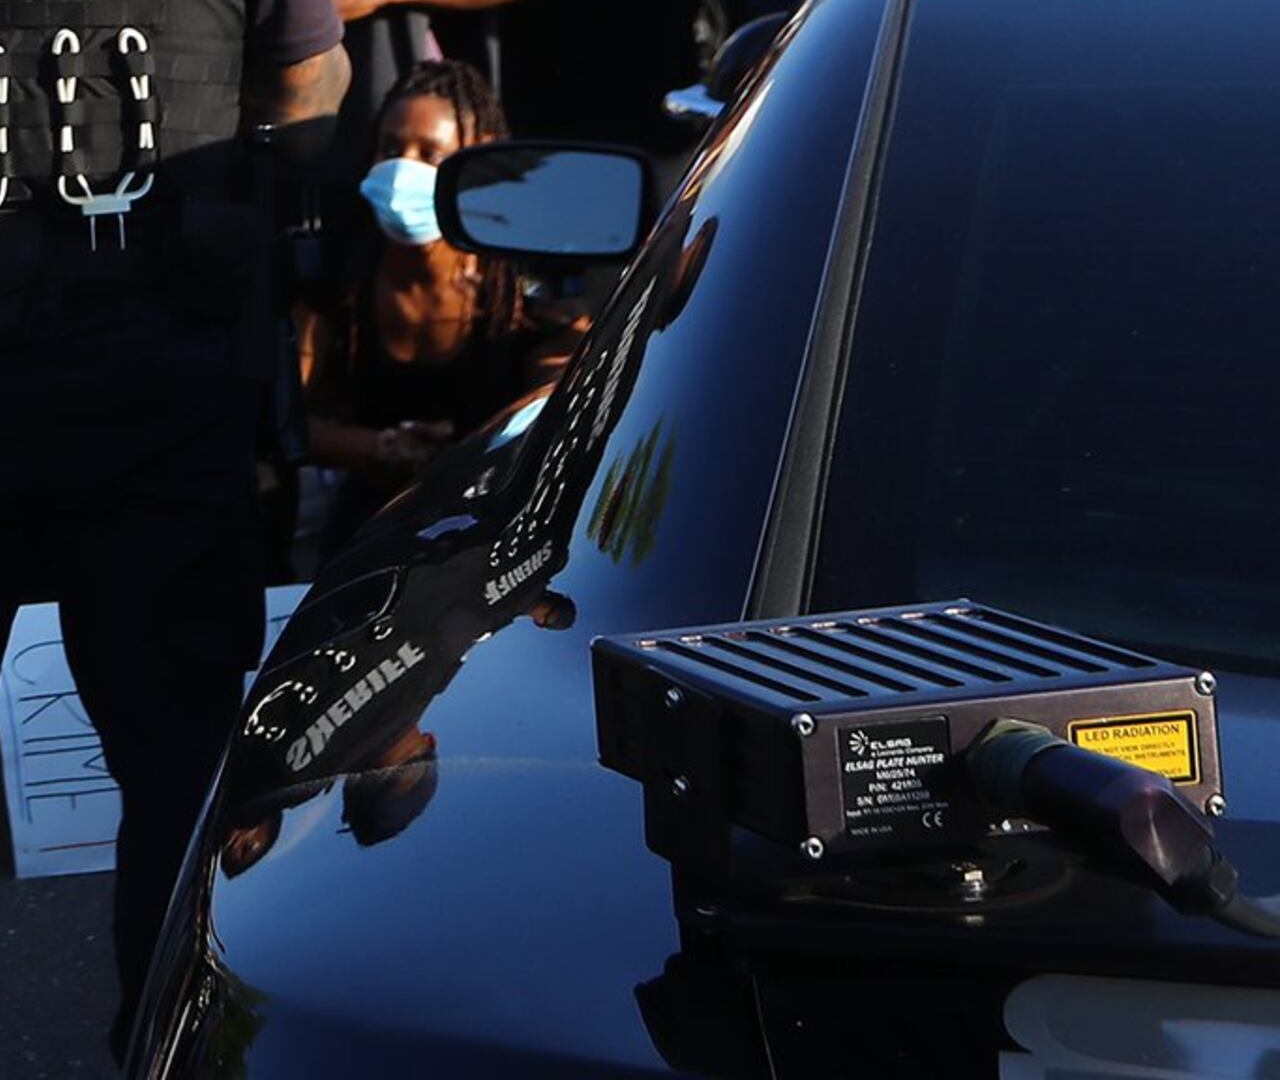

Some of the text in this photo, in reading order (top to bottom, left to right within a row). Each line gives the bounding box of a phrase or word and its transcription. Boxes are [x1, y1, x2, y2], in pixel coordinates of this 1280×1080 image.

[1085, 723, 1180, 741] LED RADIATION
[844, 753, 945, 773] ELSAG PLATE HUNTER
